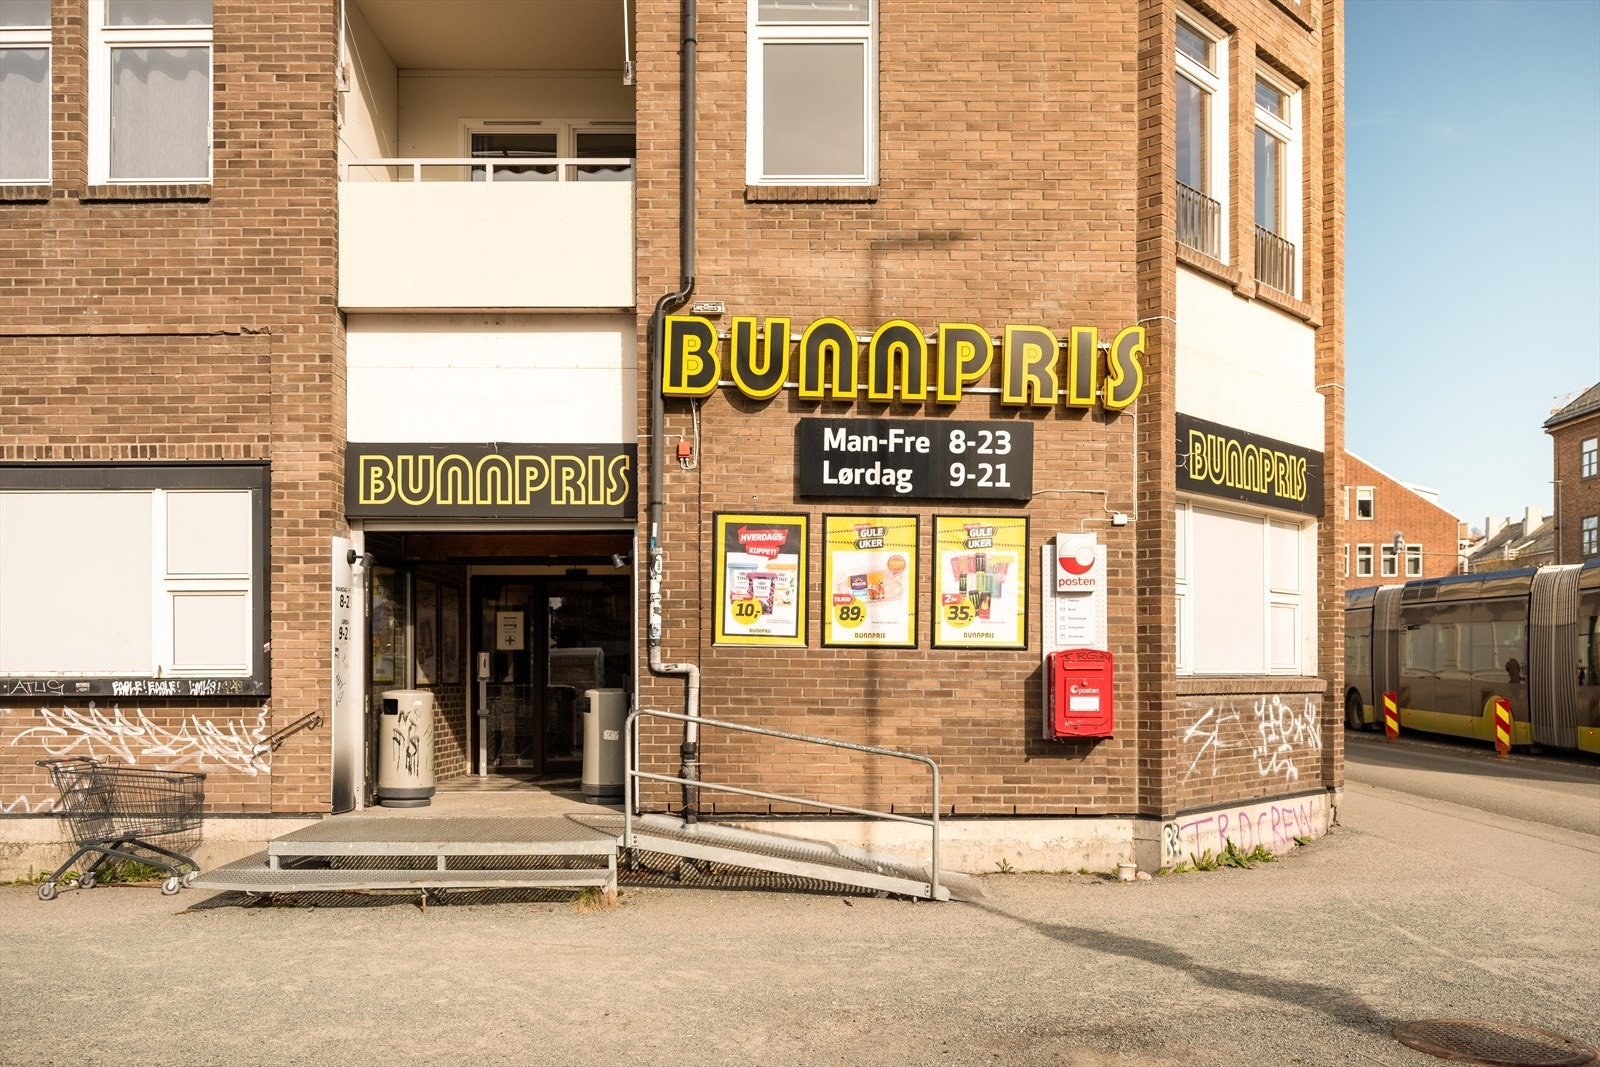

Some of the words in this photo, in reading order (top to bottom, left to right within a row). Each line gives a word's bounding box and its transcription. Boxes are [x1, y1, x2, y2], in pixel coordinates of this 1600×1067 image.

[662, 315, 1145, 412] BUNNPRIS
[823, 427, 931, 454] Man-Fre
[948, 430, 1012, 455] 8-23
[1189, 429, 1307, 501] BUNNPRIS
[359, 454, 630, 506] BUNNPRIS
[822, 460, 913, 493] Lørdag
[949, 462, 1011, 488] 9-21
[741, 532, 786, 542] HVERDAGS-
[860, 527, 884, 538] GULE
[969, 527, 993, 537] GULE
[858, 539, 883, 549] UKER
[967, 539, 992, 549] UKER
[1058, 577, 1096, 588] posten
[944, 594, 952, 603] 2
[735, 603, 761, 618] 10,-
[839, 605, 865, 622] 89,-
[948, 605, 973, 621] 35,-
[1079, 687, 1100, 695] posten
